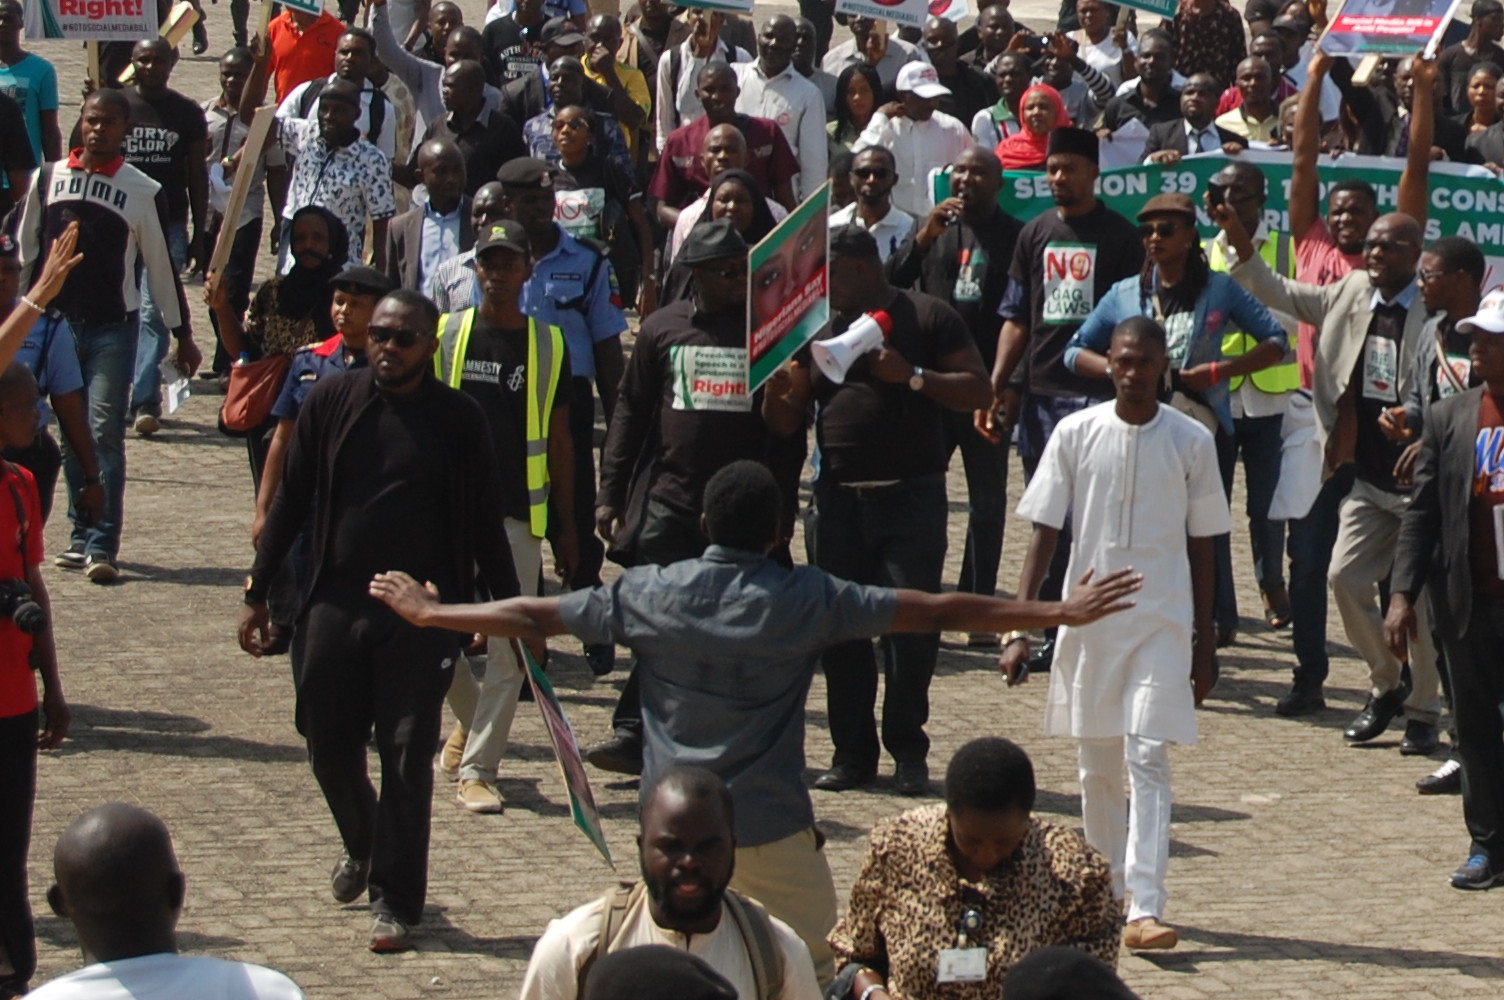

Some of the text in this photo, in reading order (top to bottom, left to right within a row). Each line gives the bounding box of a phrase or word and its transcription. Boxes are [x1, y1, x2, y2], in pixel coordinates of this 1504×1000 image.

[127, 139, 175, 153] GLORY
[1014, 173, 1148, 199] SEION
[1160, 171, 1197, 194] 39
[1048, 252, 1091, 281] NO
[1052, 288, 1082, 300] GAG
[1047, 301, 1091, 315] LAWS
